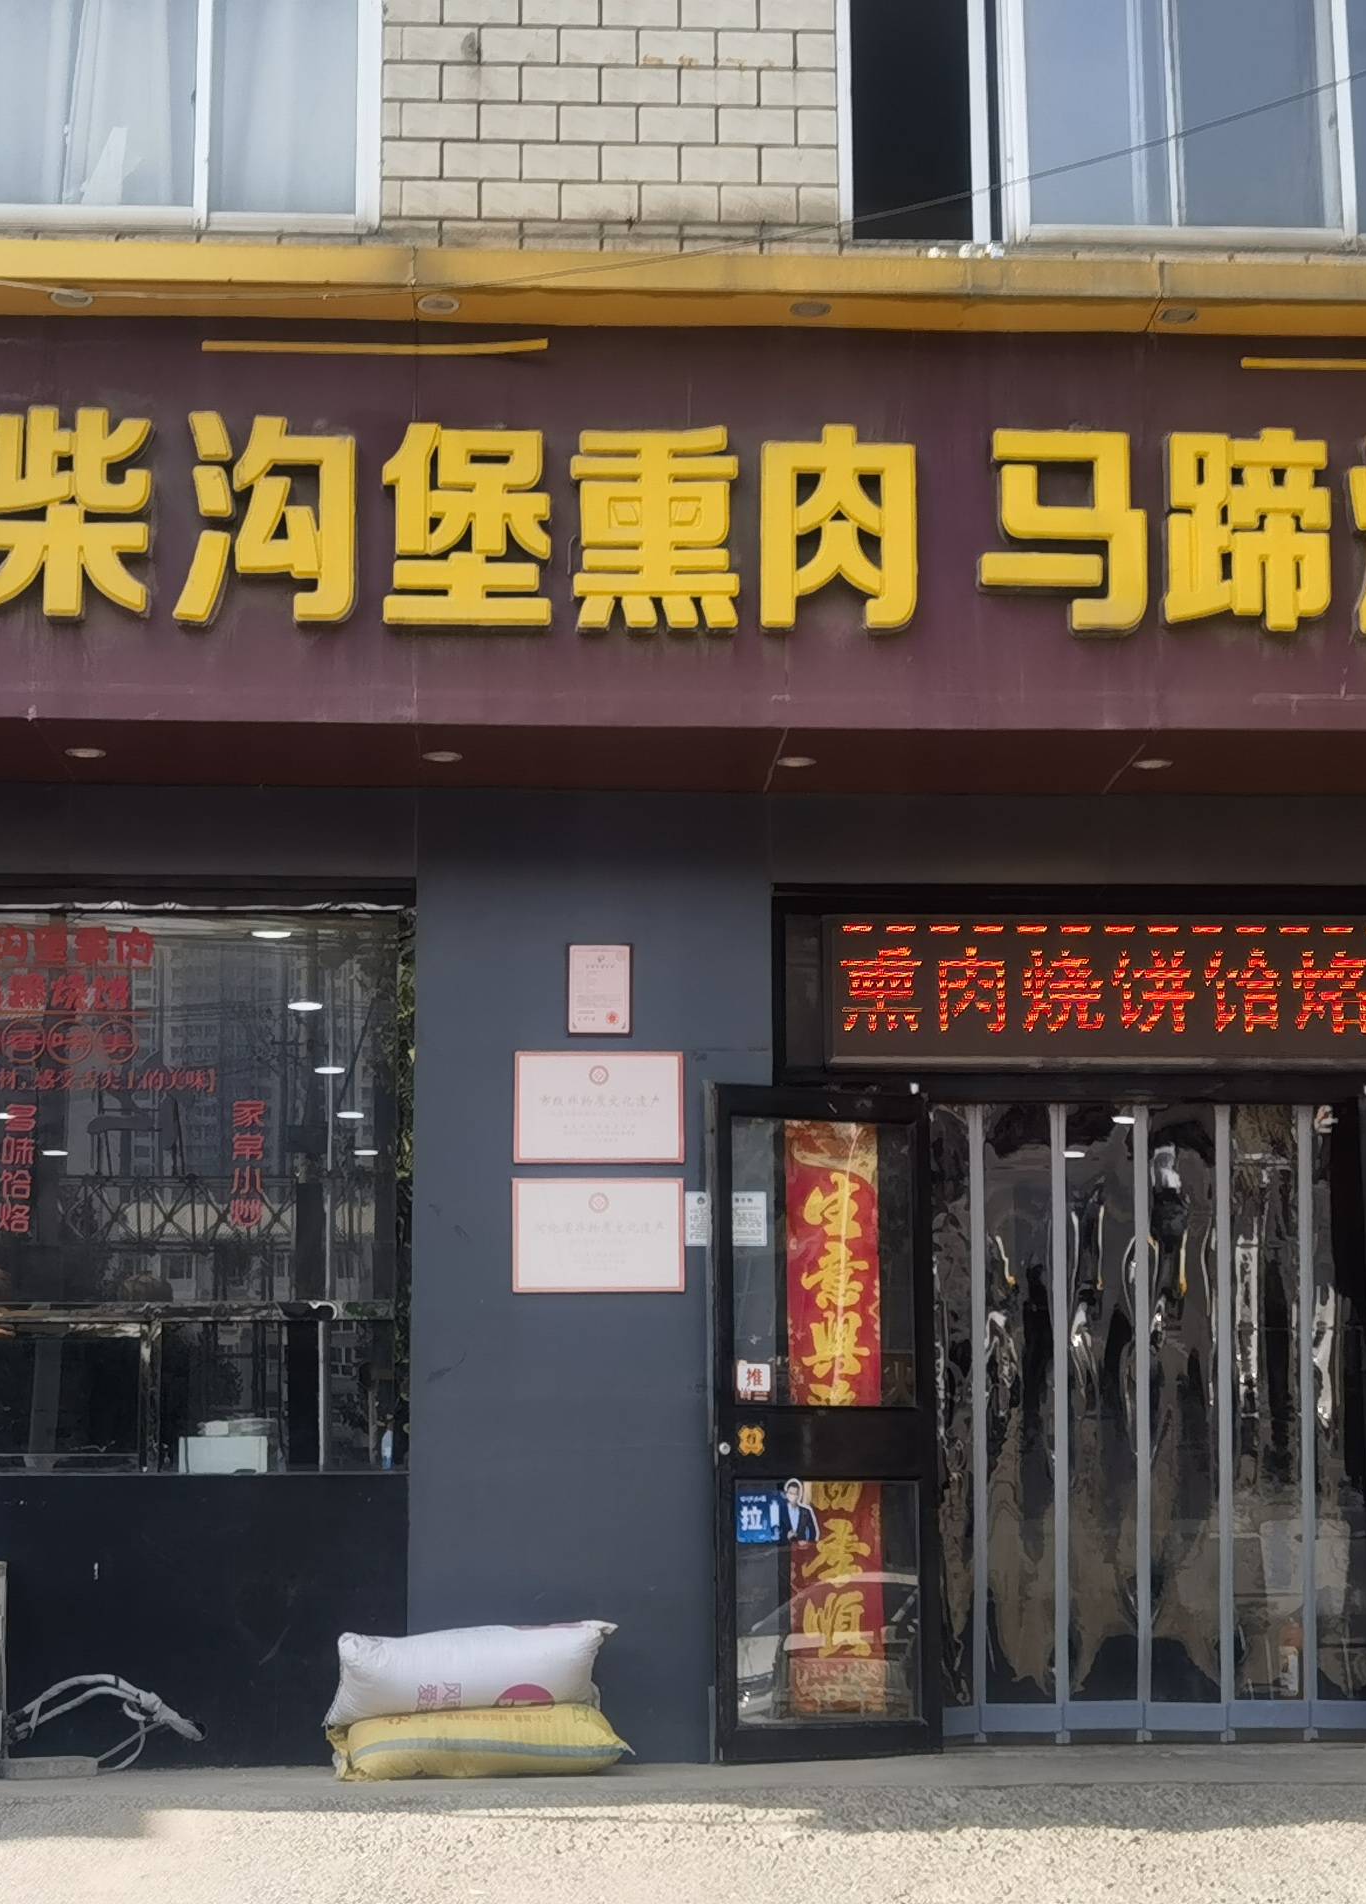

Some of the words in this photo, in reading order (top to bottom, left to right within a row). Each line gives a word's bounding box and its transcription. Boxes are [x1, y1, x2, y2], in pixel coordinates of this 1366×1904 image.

[231, 1100, 265, 1230] 家常小炒
[740, 1506, 763, 1531] 拉
